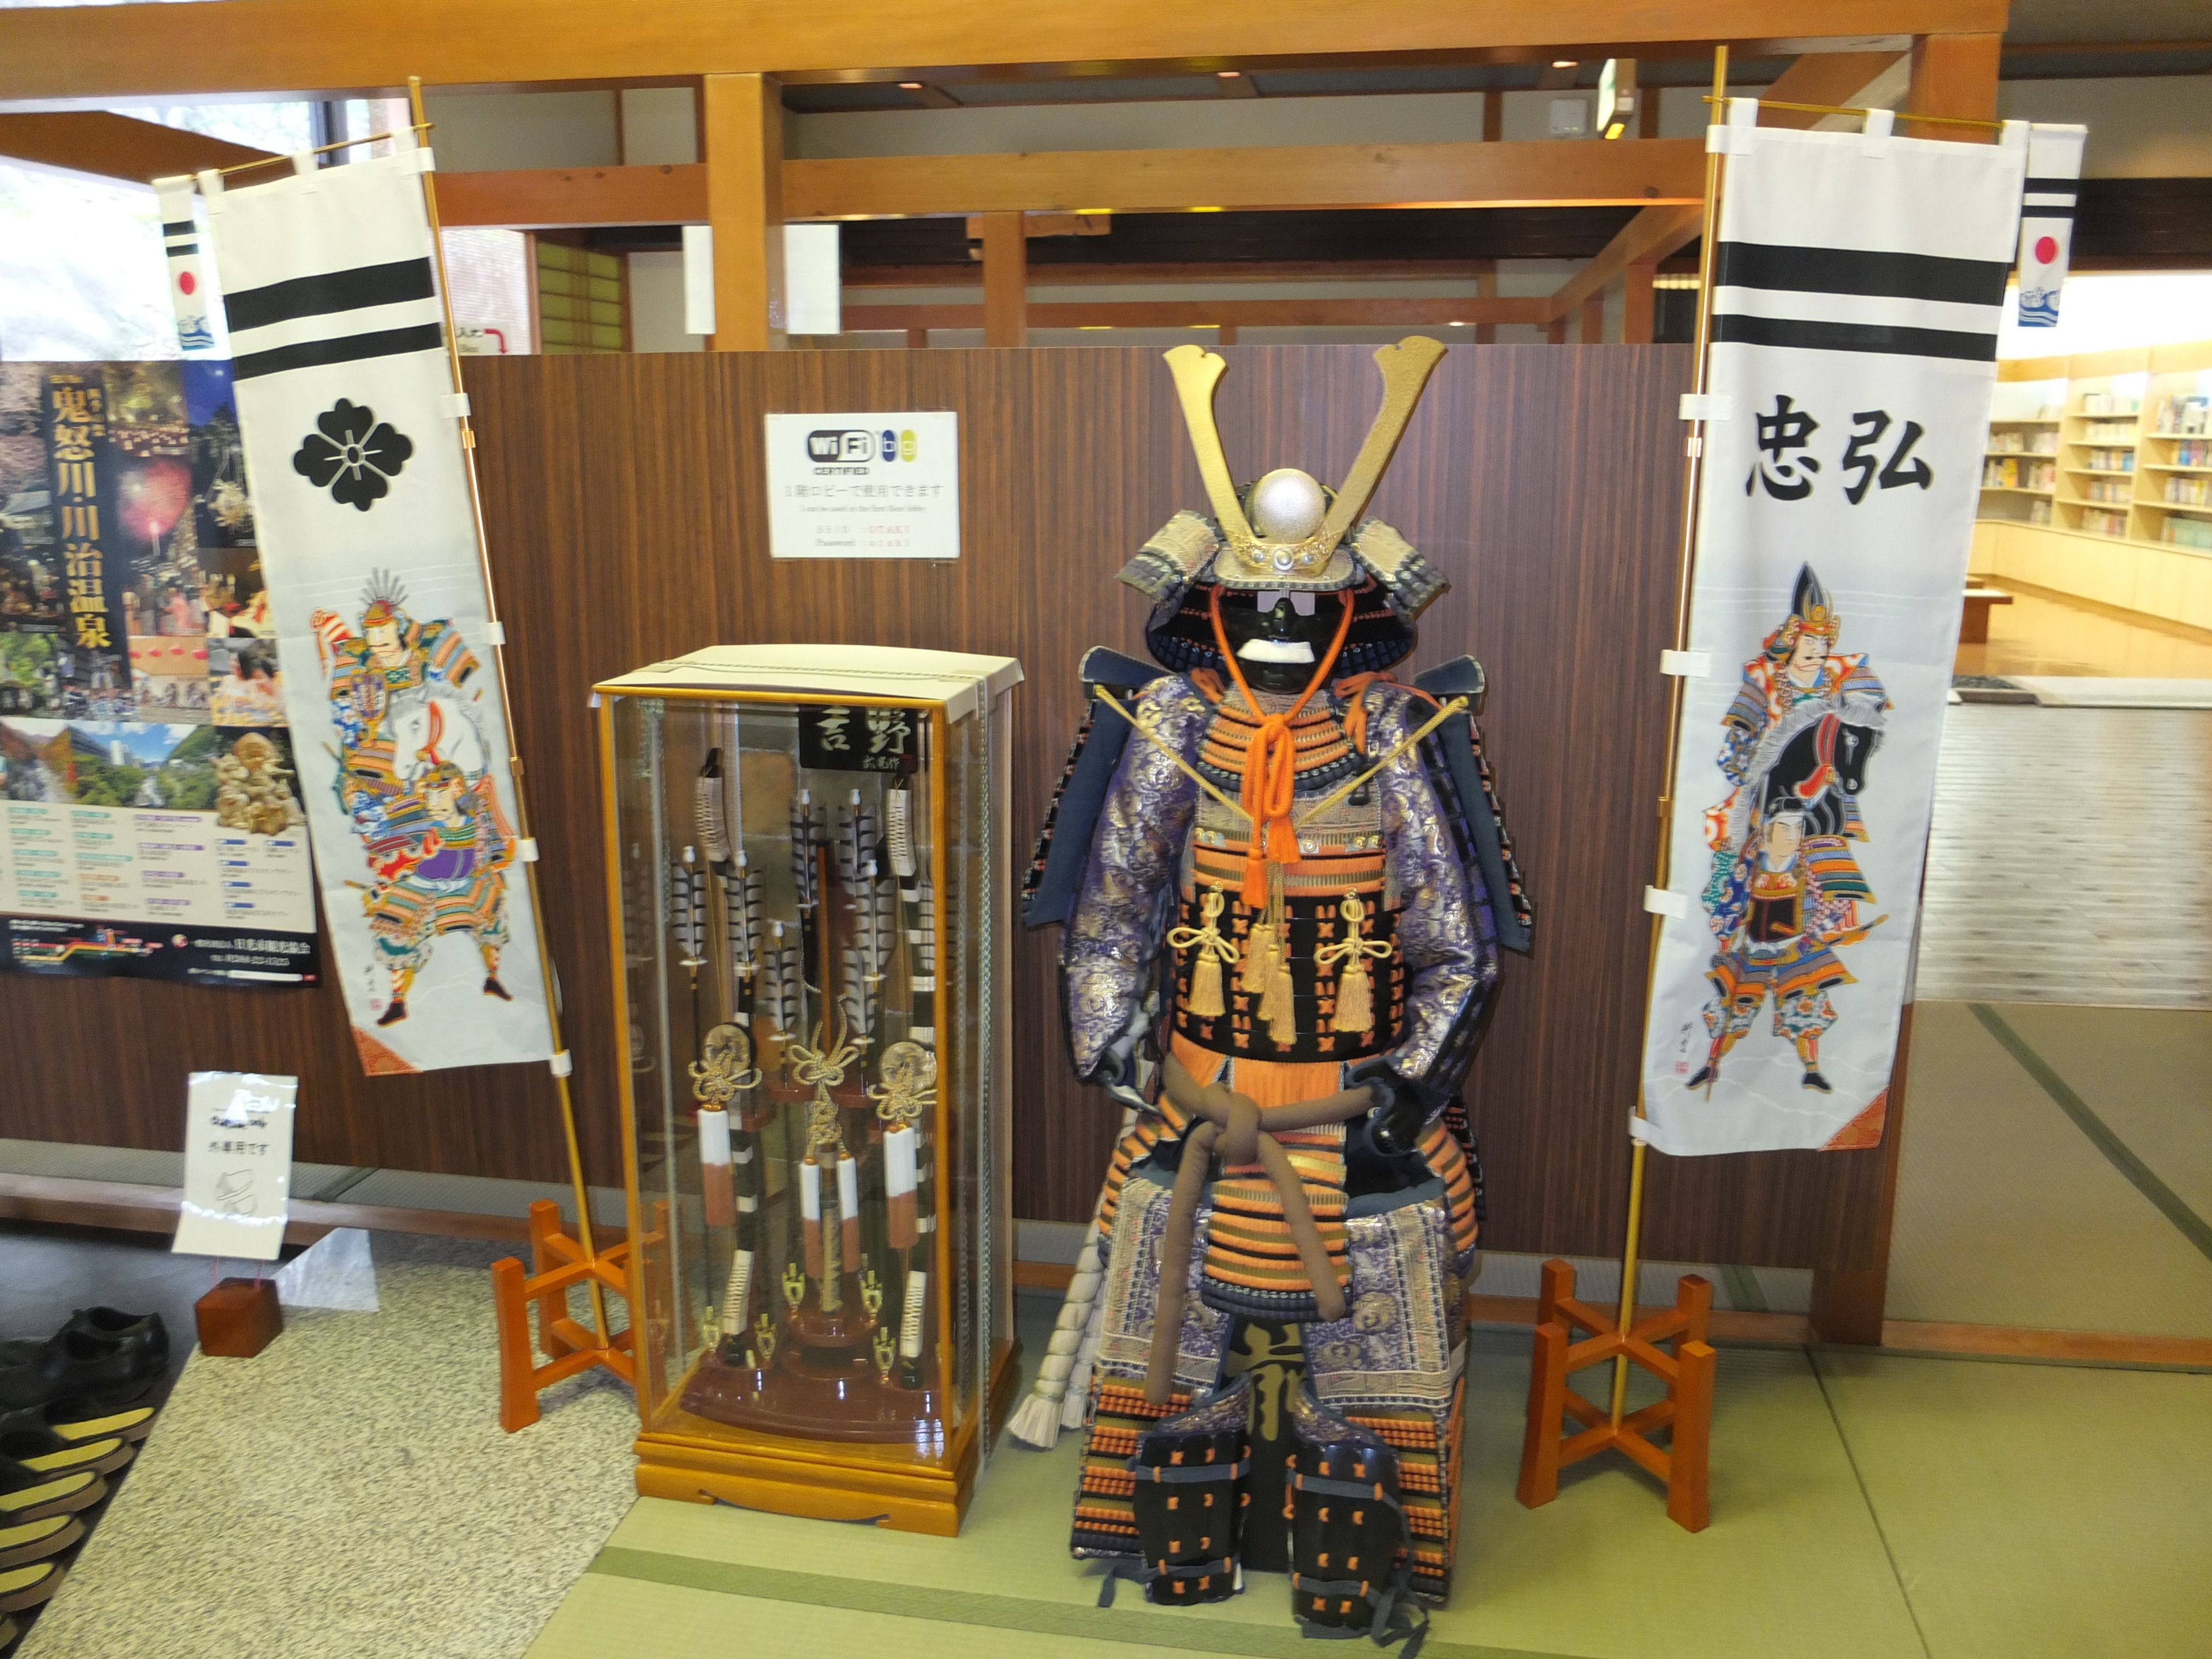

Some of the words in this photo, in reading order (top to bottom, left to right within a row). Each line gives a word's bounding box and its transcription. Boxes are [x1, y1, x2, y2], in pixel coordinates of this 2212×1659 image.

[813, 467, 870, 476] CERTIFIED
[1745, 393, 1934, 506] 忠弘
[51, 387, 112, 649] 鬼怒川・川治温泉
